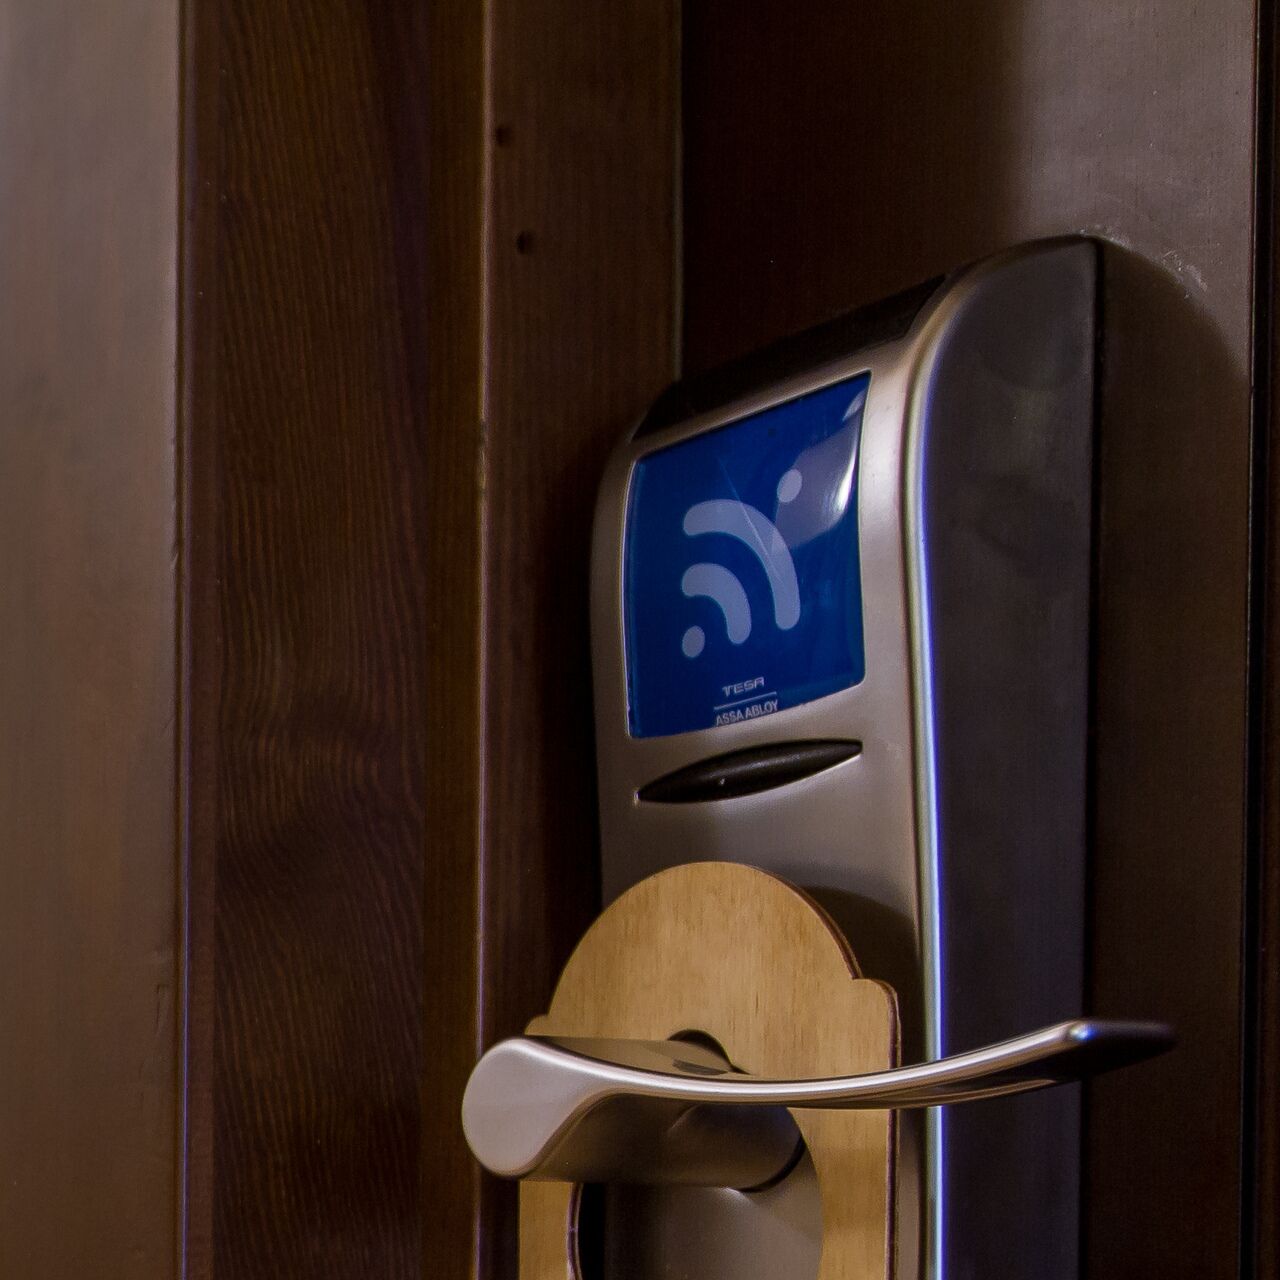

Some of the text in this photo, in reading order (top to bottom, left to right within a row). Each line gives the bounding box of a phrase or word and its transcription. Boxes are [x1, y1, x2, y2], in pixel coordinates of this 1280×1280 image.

[722, 676, 765, 696] TESA
[716, 699, 778, 726] ASSA ABLOY
